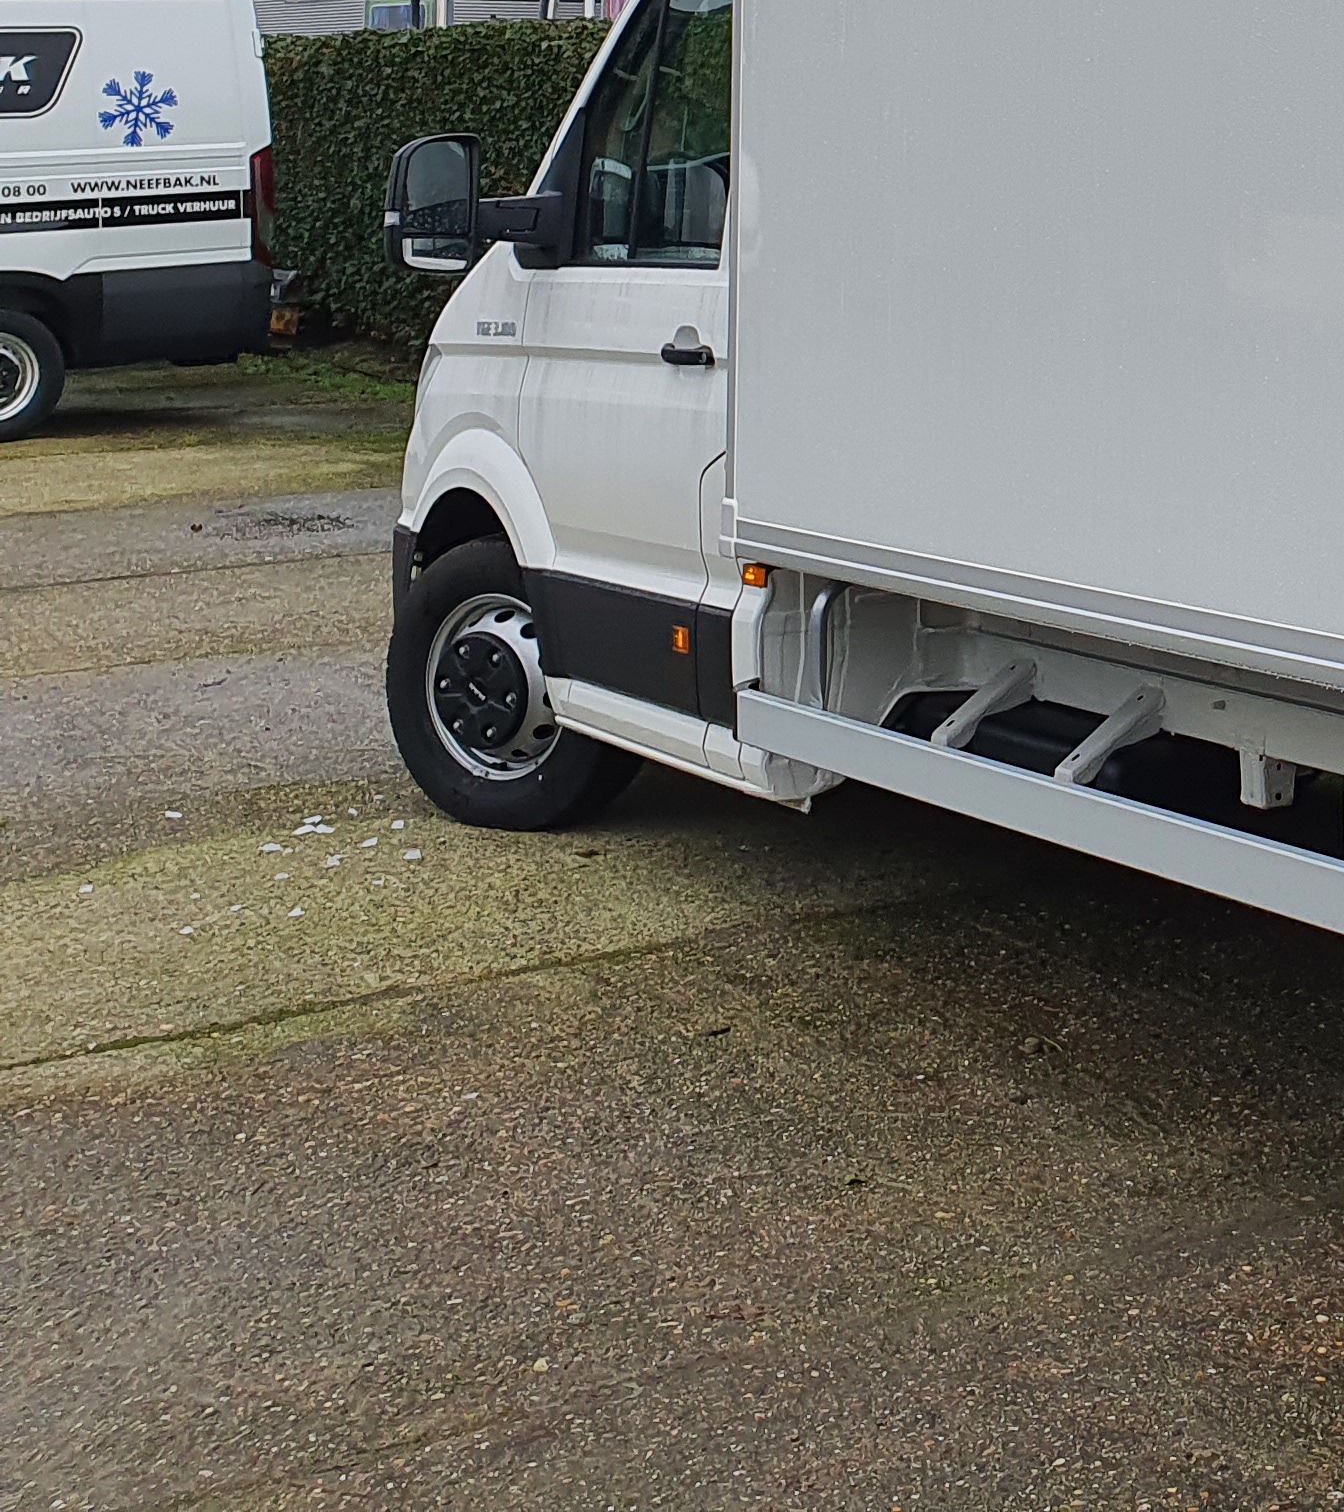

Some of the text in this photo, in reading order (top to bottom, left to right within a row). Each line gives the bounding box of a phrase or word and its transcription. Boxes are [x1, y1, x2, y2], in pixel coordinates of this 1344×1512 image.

[1, 174, 220, 198] 08 00 WWW.NEEFBAK.NL
[132, 202, 175, 217] TRUCK
[176, 199, 237, 214] VERHUUR
